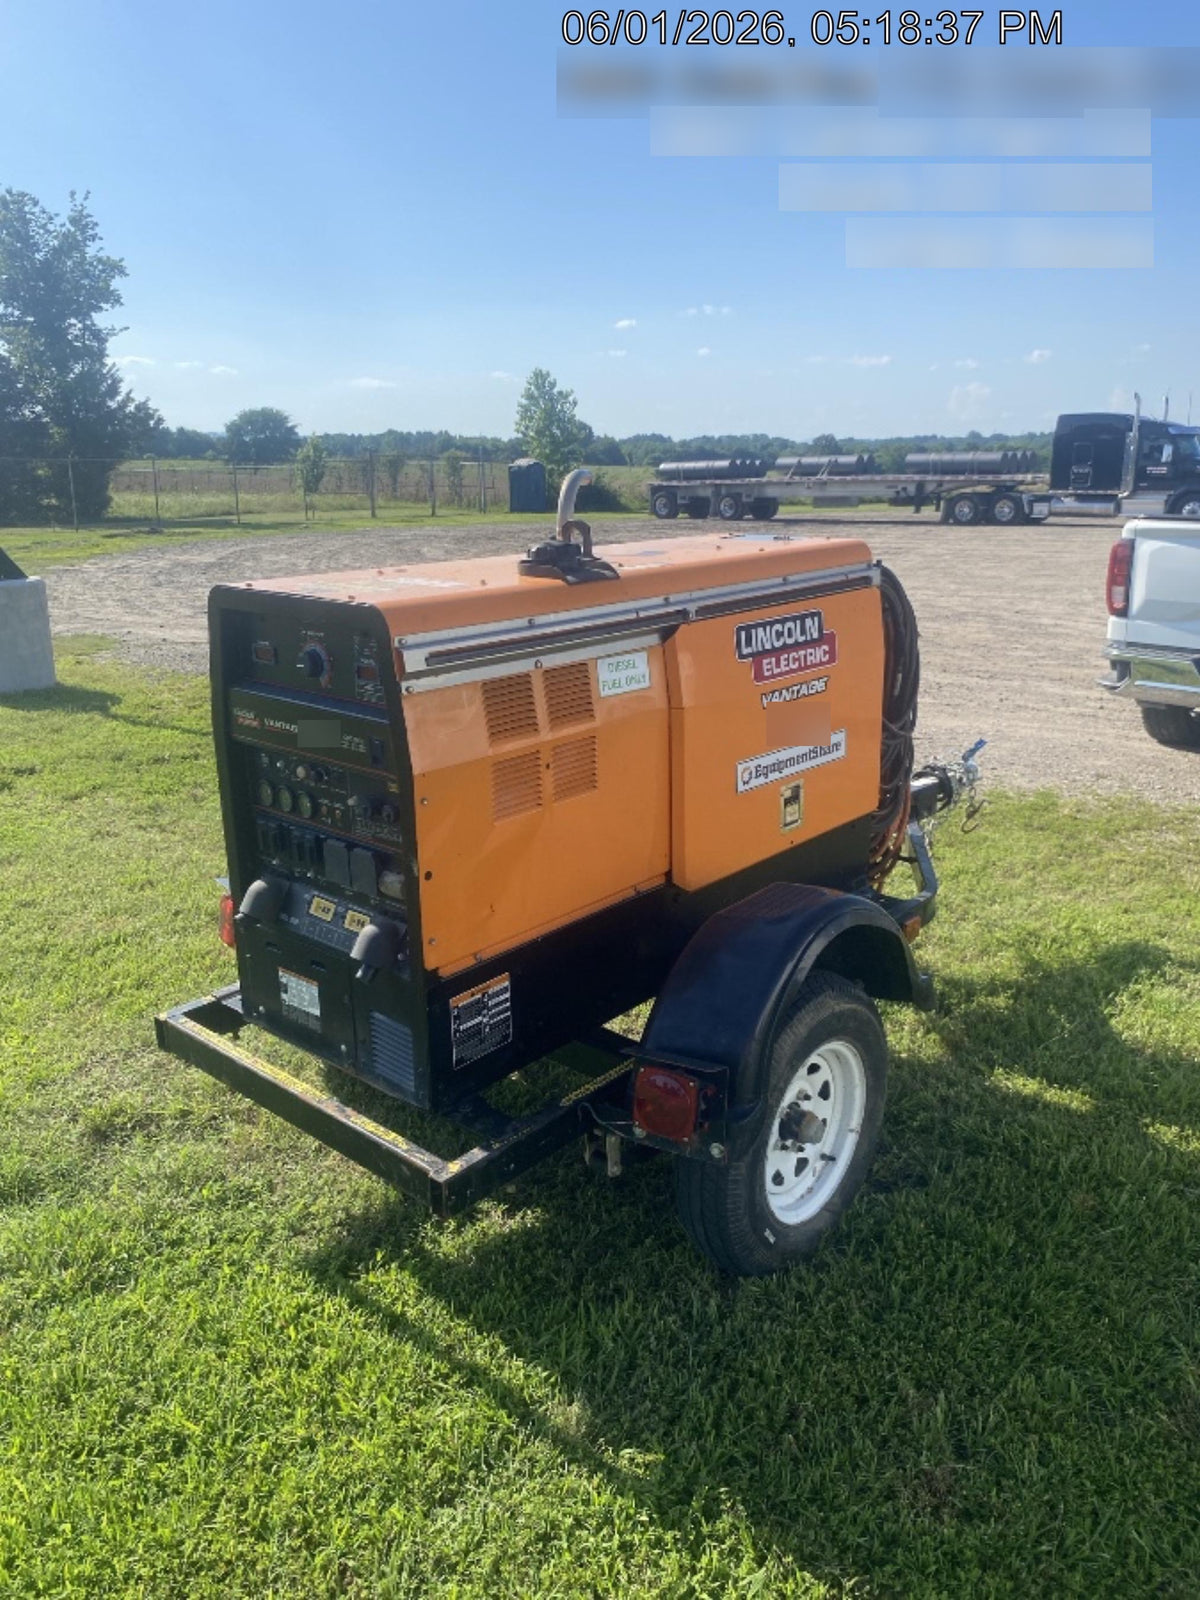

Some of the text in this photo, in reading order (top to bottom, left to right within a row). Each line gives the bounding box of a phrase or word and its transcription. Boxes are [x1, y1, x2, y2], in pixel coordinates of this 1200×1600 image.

[740, 616, 819, 655] LINCOLN
[607, 659, 638, 673] DIESEL
[762, 644, 830, 677] ELECTRIC
[602, 674, 646, 692] FUEL ONLY
[761, 676, 830, 709] VANTAGE
